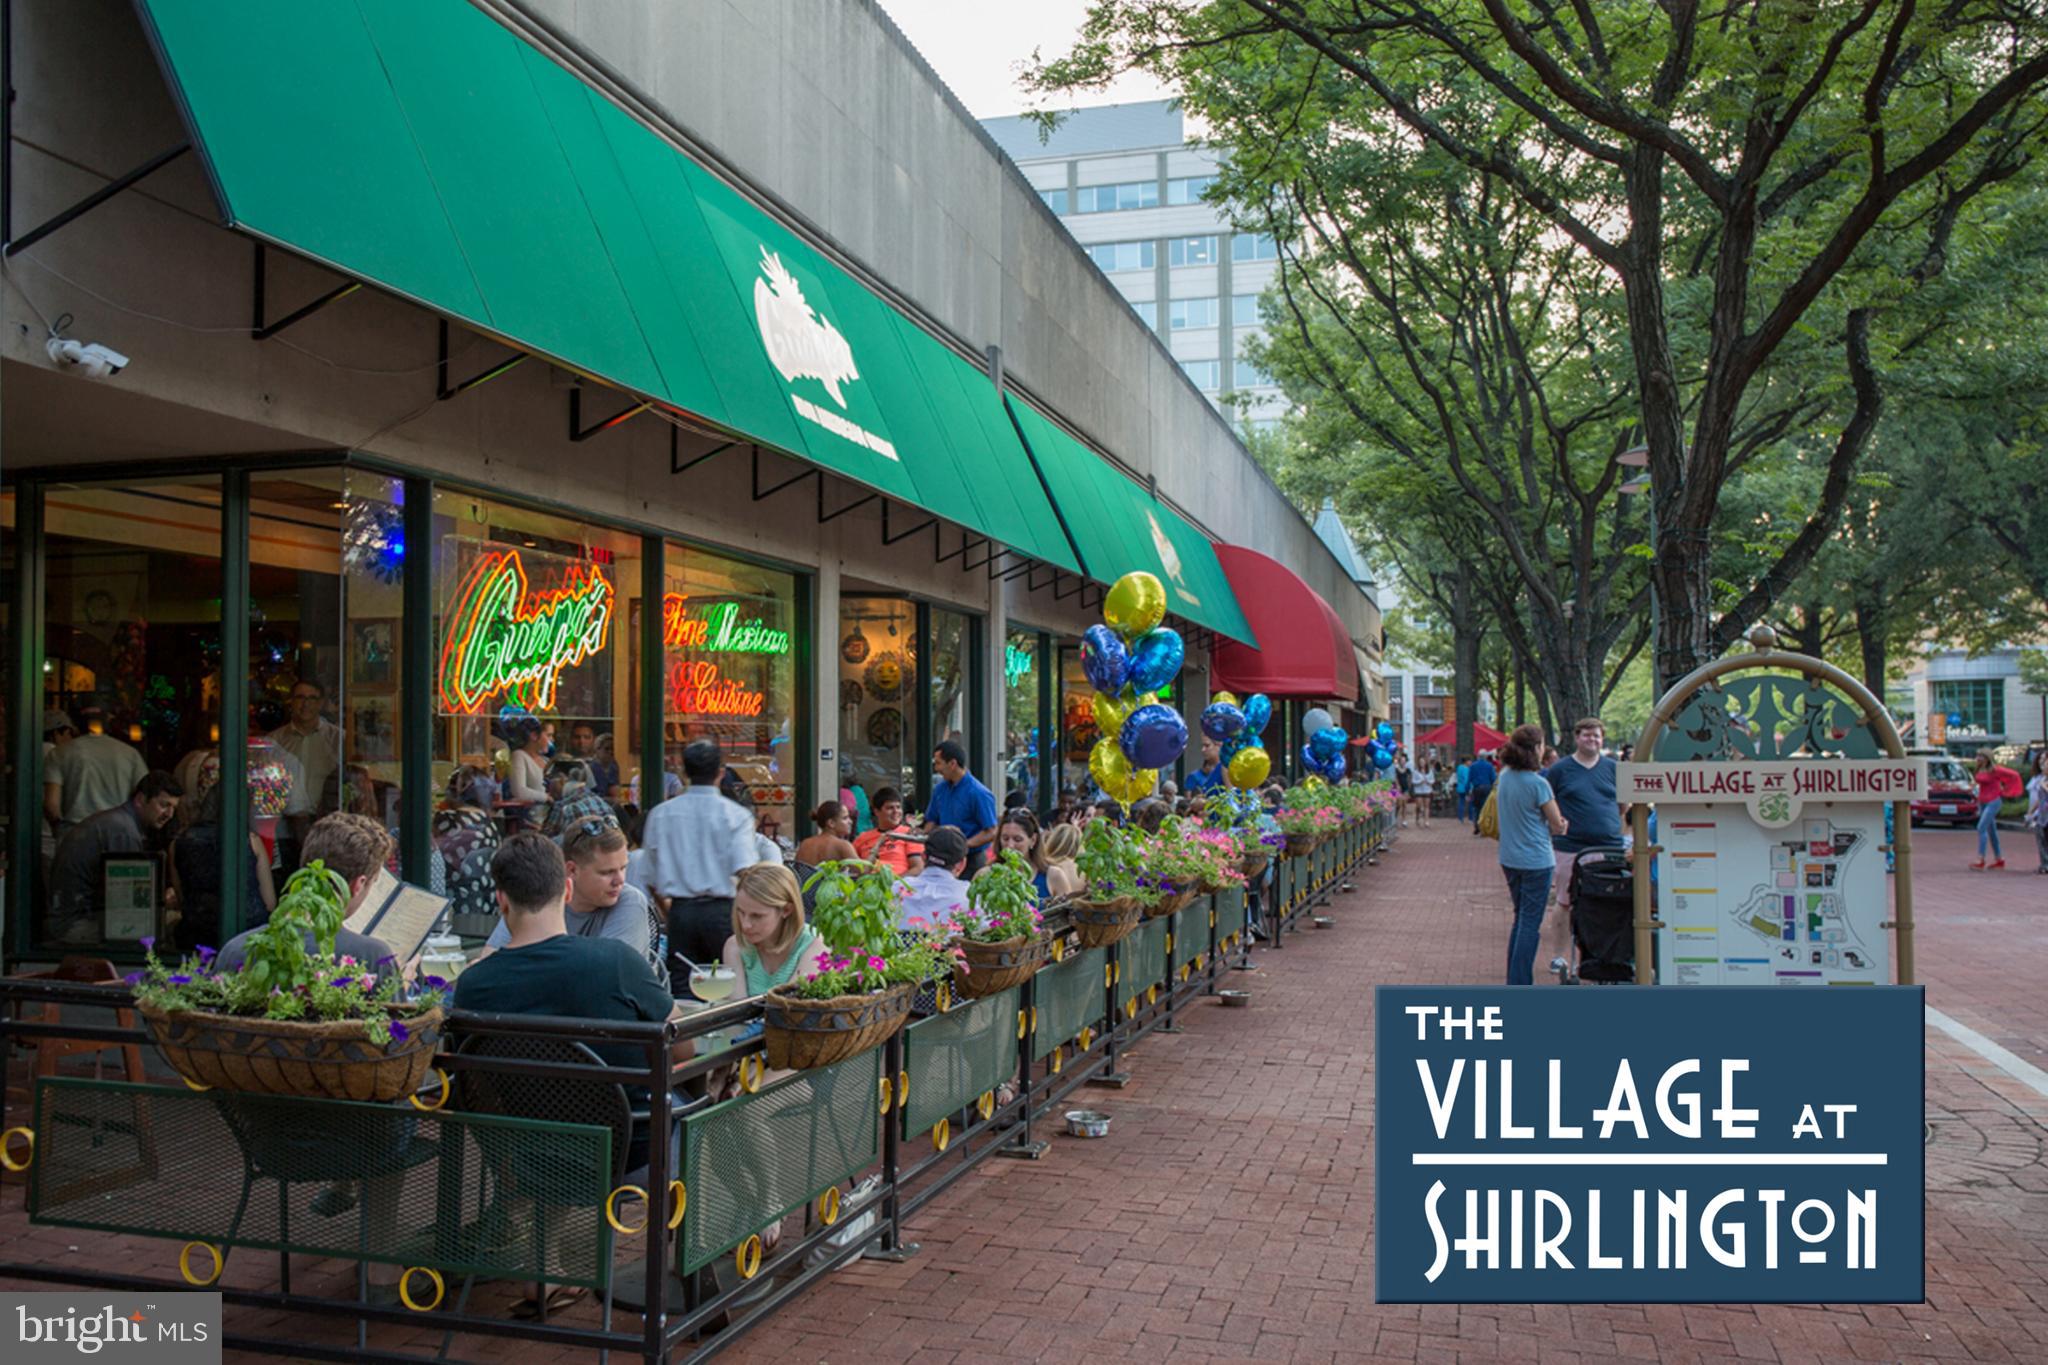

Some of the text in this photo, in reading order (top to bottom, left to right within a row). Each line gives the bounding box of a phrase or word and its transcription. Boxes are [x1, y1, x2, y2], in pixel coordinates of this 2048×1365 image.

[664, 592, 789, 654] Fine Mexican
[694, 661, 763, 717] Cuisine
[1634, 767, 1917, 796] THE VILLAGE AT SHIRLINGTON
